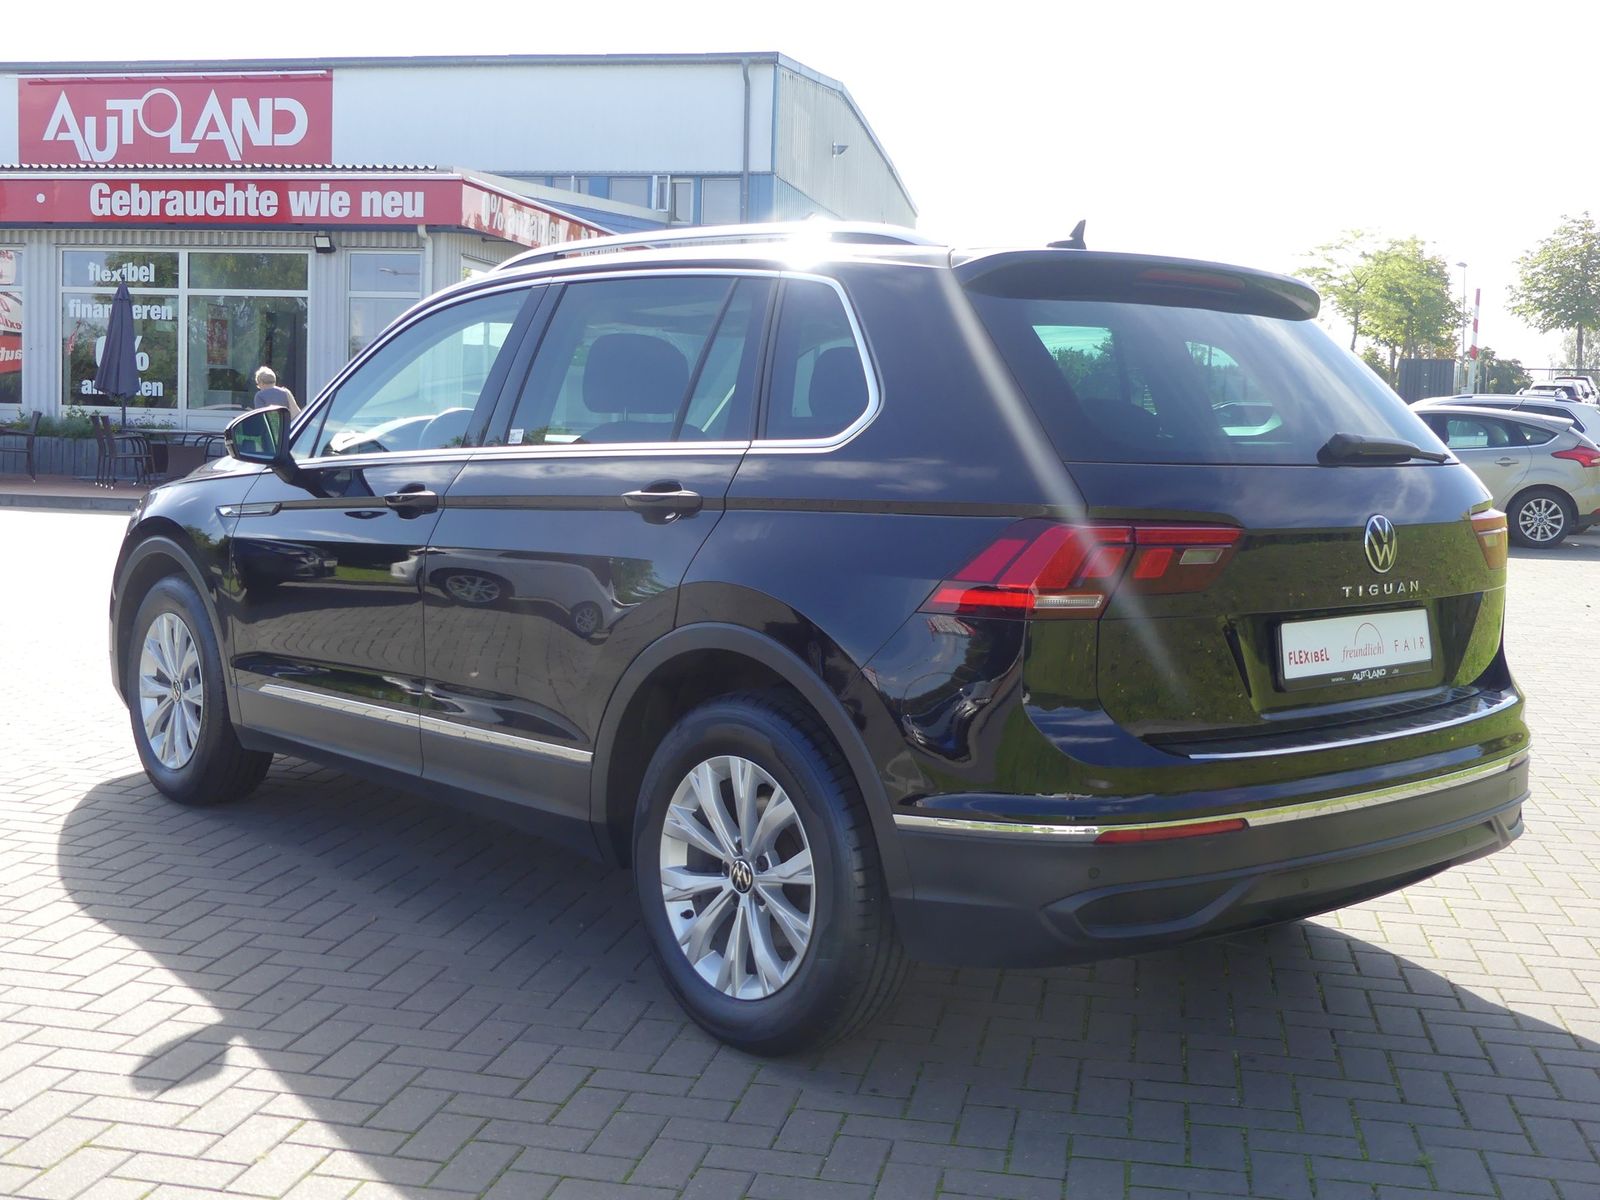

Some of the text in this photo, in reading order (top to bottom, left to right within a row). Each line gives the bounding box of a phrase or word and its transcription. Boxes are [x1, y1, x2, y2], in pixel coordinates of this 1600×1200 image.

[90, 183, 424, 217] Gebrauchte wie neu
[481, 191, 504, 231] 0%
[88, 262, 155, 282] flexibel
[1342, 580, 1419, 598] TIGUAN
[1288, 636, 1425, 665] FLEXIBEL freundlich FAIR
